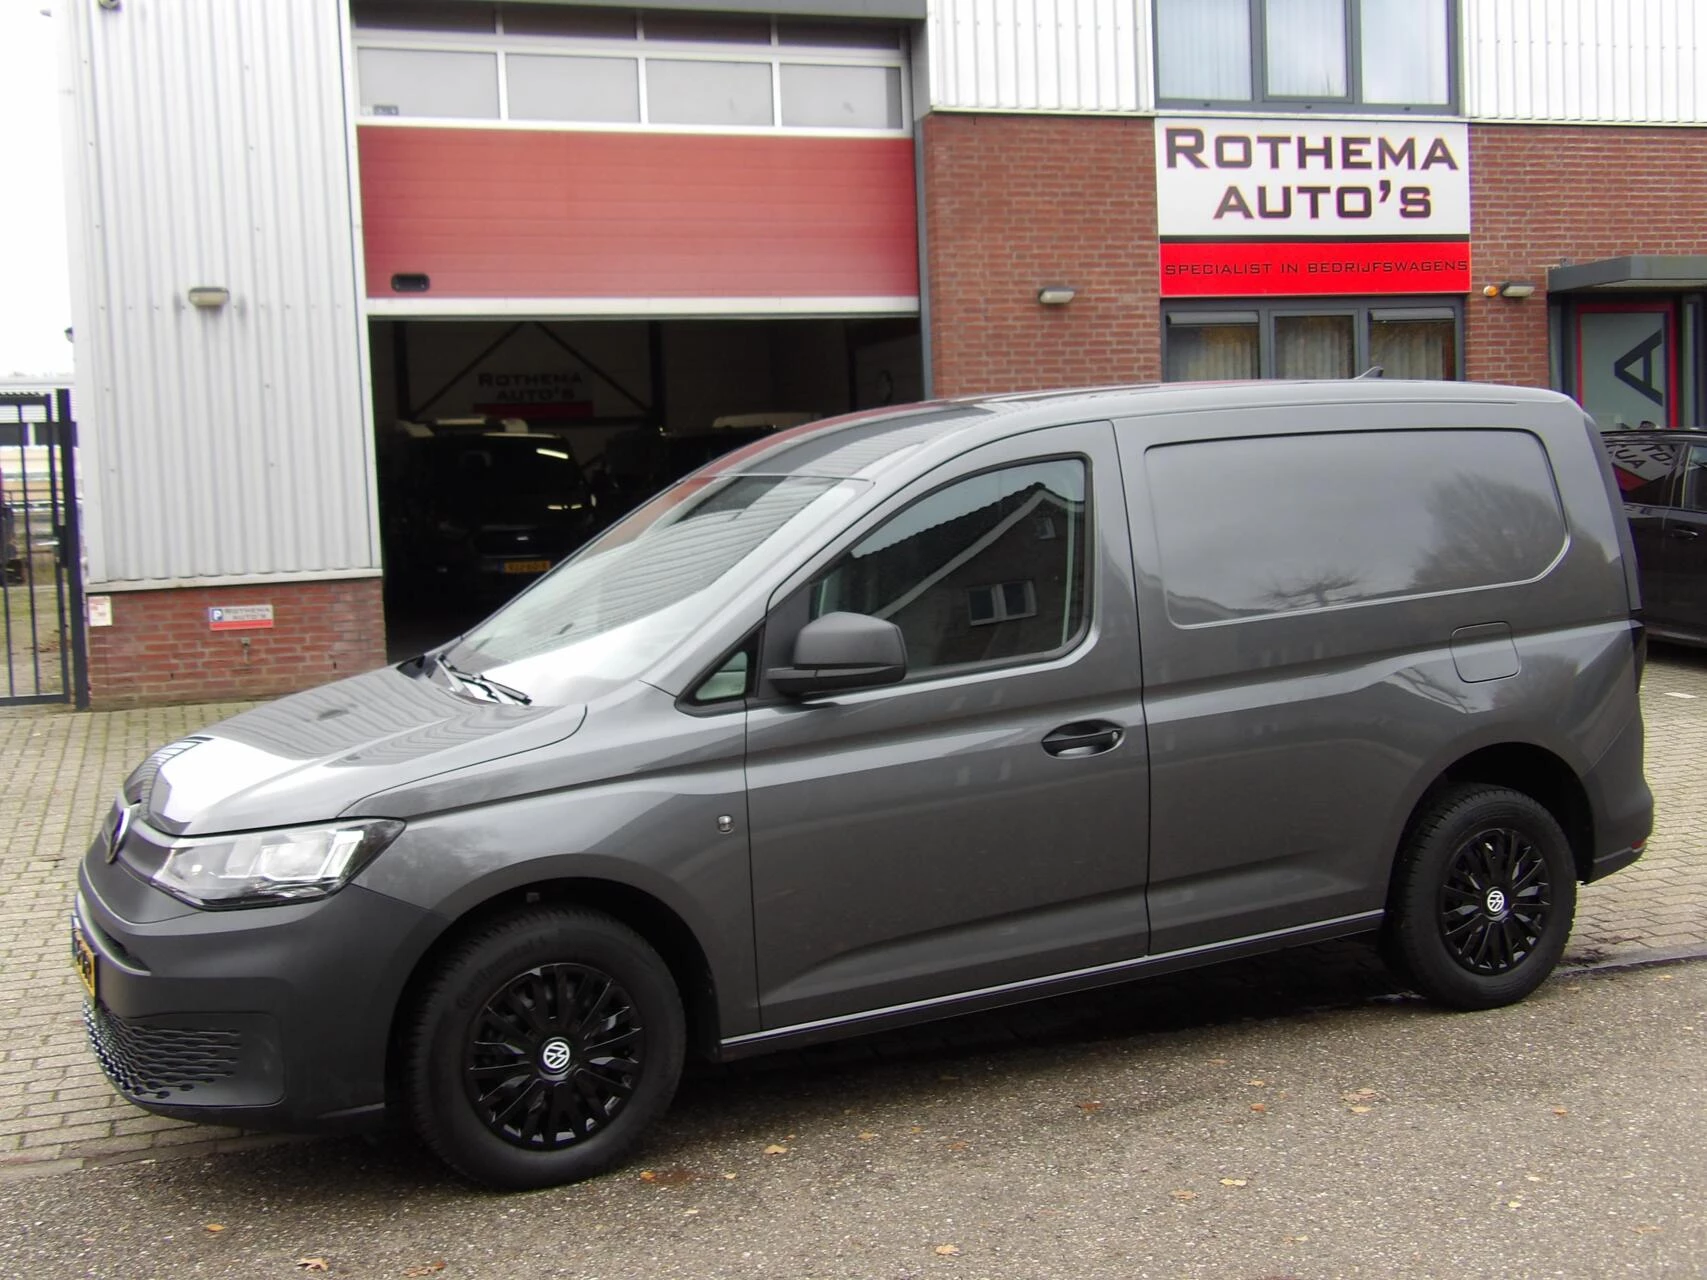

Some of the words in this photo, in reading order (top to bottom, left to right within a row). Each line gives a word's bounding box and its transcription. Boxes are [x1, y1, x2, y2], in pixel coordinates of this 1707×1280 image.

[1165, 127, 1459, 170] ROTHEMA
[1212, 179, 1432, 220] AUTO'S
[1165, 263, 1273, 275] SPECIALIST
[1280, 263, 1299, 274] IN
[1307, 260, 1468, 273] BEDRIJFSWAGENS
[478, 372, 583, 387] ROTHEMA
